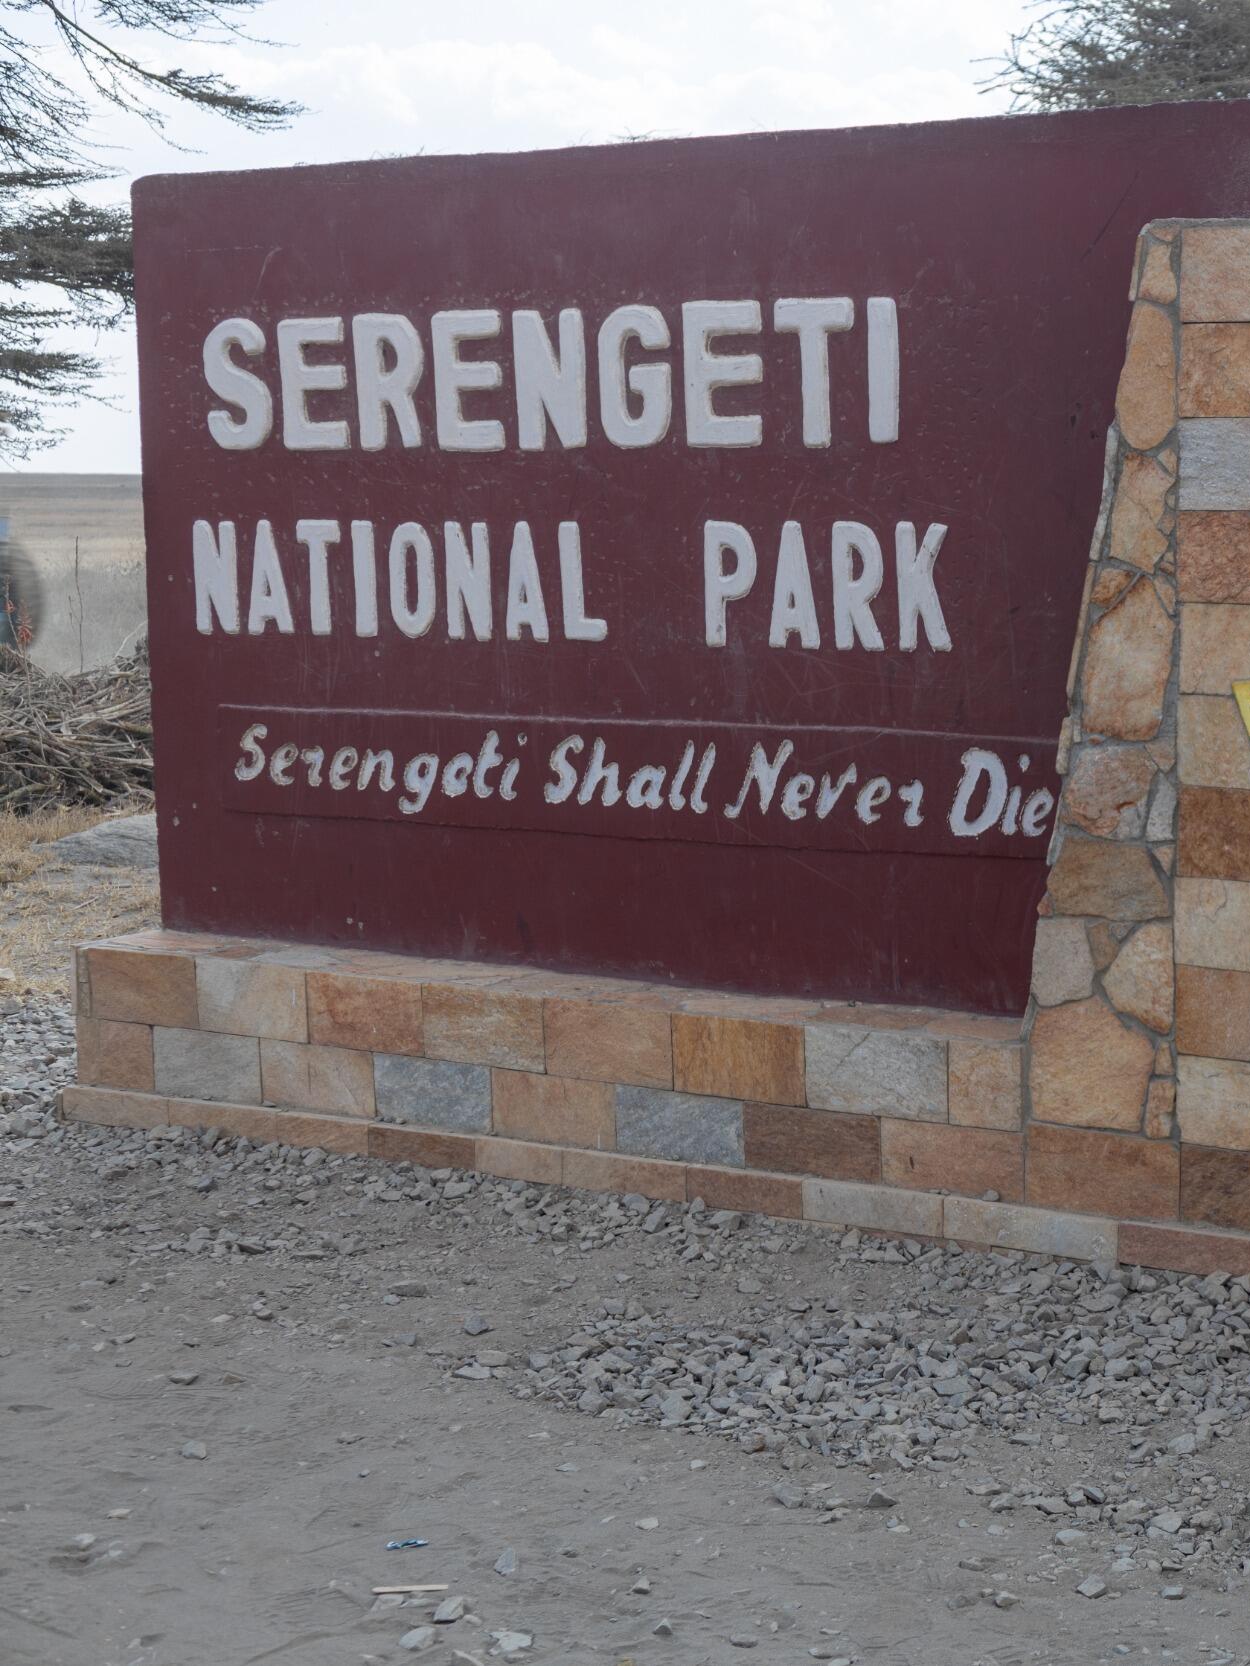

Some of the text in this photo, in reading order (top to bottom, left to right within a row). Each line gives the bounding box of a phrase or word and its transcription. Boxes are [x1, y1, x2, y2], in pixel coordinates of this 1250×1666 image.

[202, 295, 900, 453] SERENGETI
[191, 518, 954, 653] NATIONAL PARK
[233, 722, 1055, 838] Serengeti Shall Never Die
